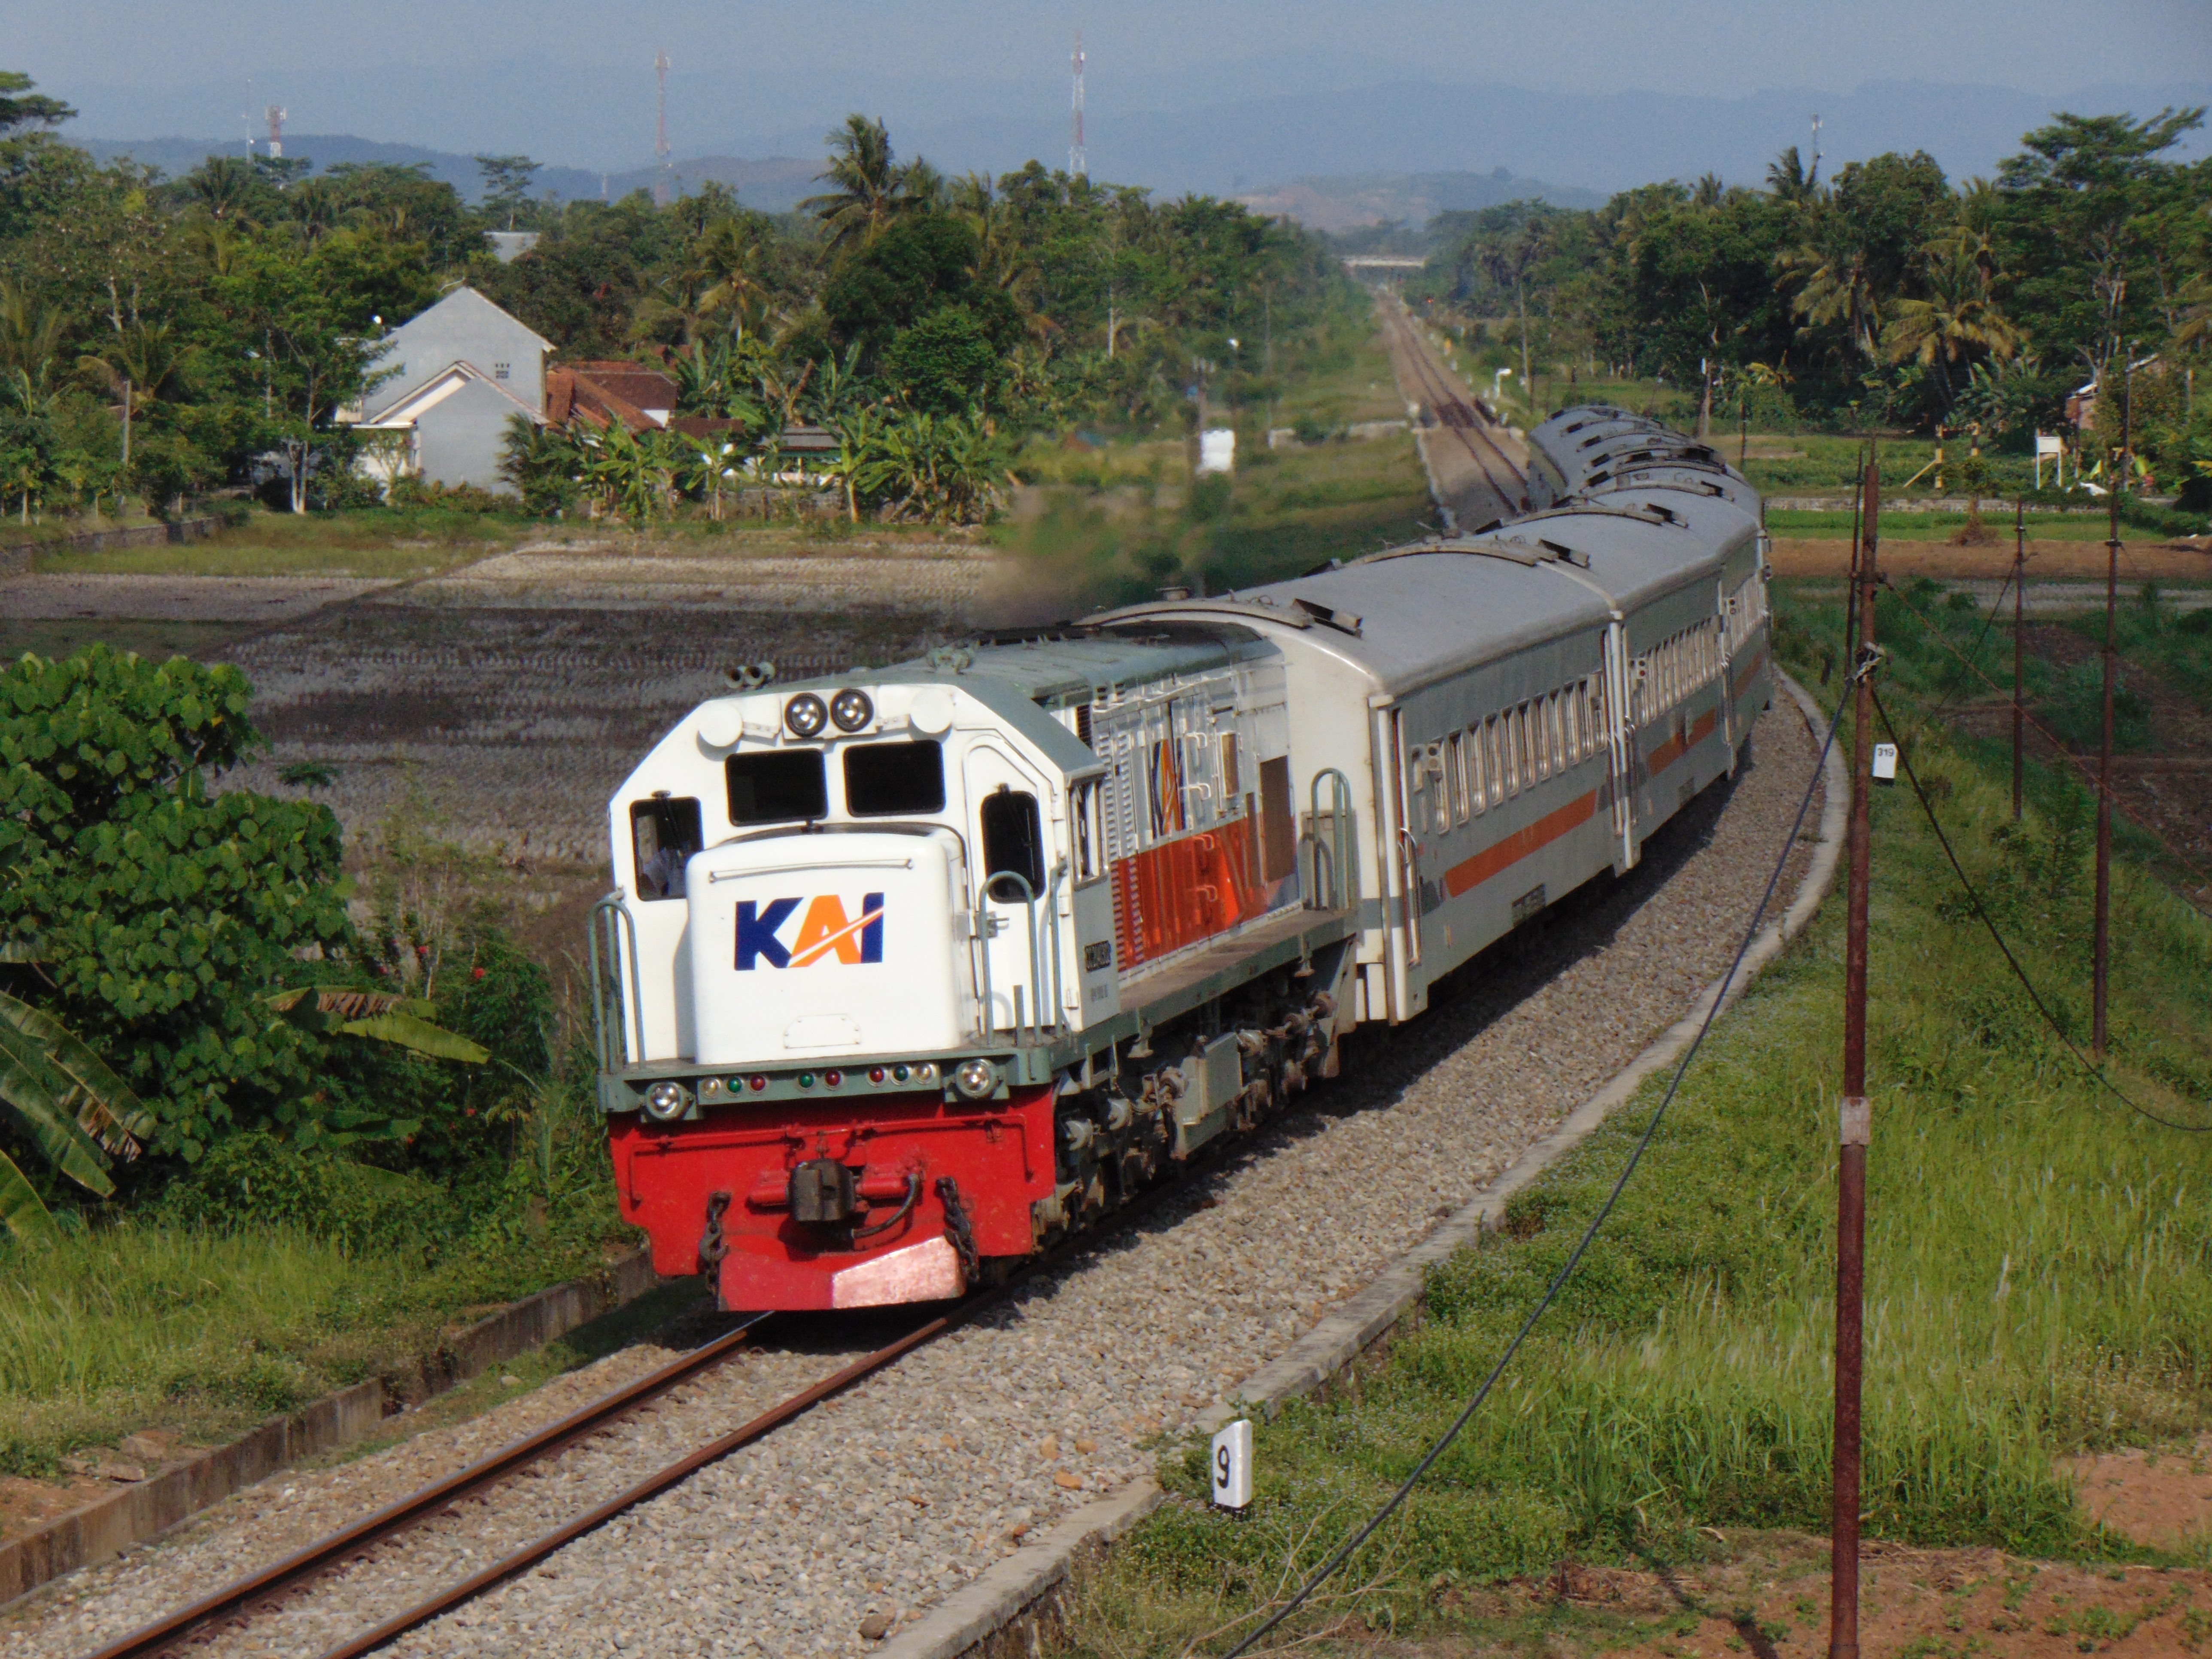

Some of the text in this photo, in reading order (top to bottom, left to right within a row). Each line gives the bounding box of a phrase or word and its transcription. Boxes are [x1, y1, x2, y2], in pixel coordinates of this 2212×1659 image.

[1878, 747, 1894, 757] 319
[734, 892, 884, 971] KAI
[1217, 1445, 1230, 1489] 9
